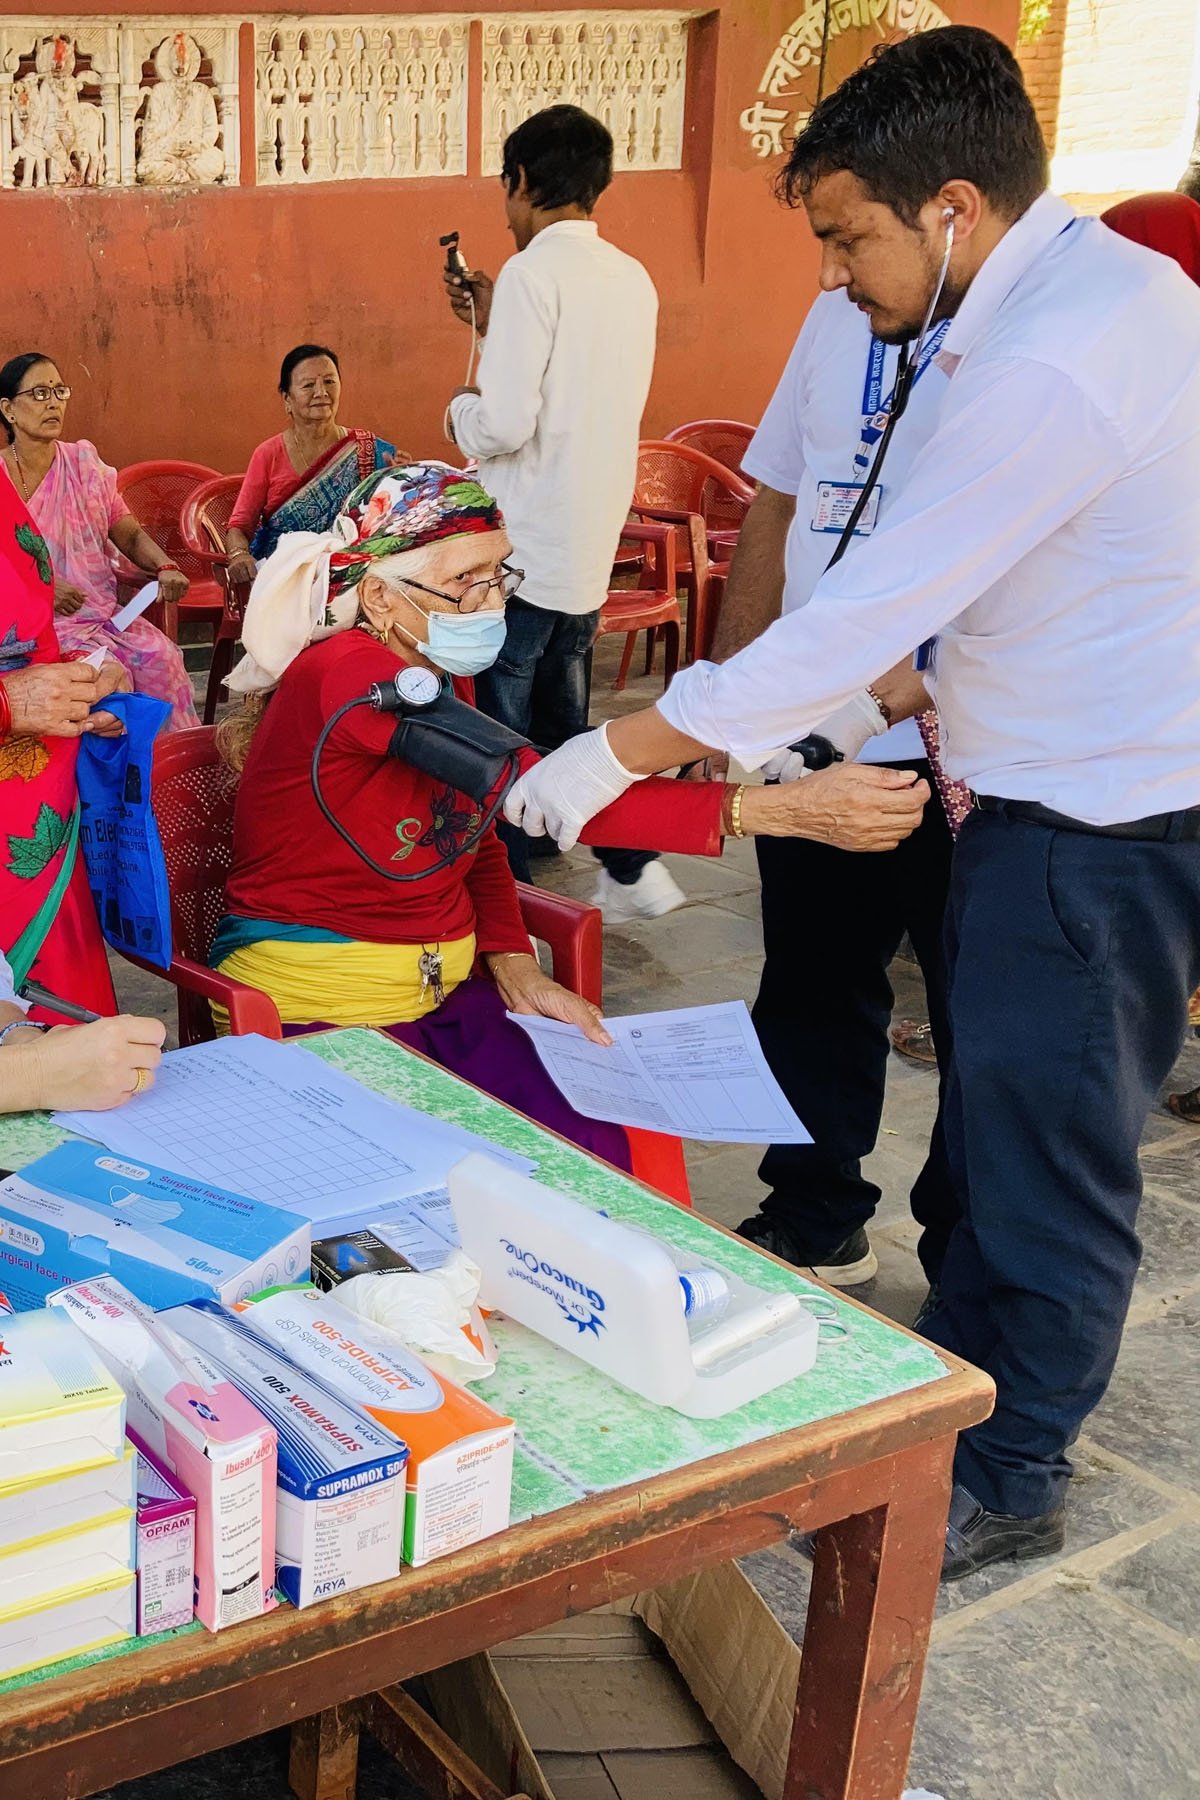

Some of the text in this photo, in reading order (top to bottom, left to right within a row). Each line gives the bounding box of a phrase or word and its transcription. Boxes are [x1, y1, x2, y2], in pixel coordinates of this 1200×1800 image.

[159, 1175, 256, 1212] Surgical face mask
[35, 1263, 58, 1281] face
[275, 1318, 302, 1335] USP
[311, 1320, 414, 1392] AZIPRIDE-500
[262, 1374, 364, 1453] SUPRAMOX 500
[355, 1424, 385, 1447] ARYA
[224, 1443, 271, 1477] Ibusar 400
[316, 1464, 385, 1499] SUPRAMOX
[146, 1518, 190, 1538] OPRAM
[313, 1578, 347, 1596] ARYA
